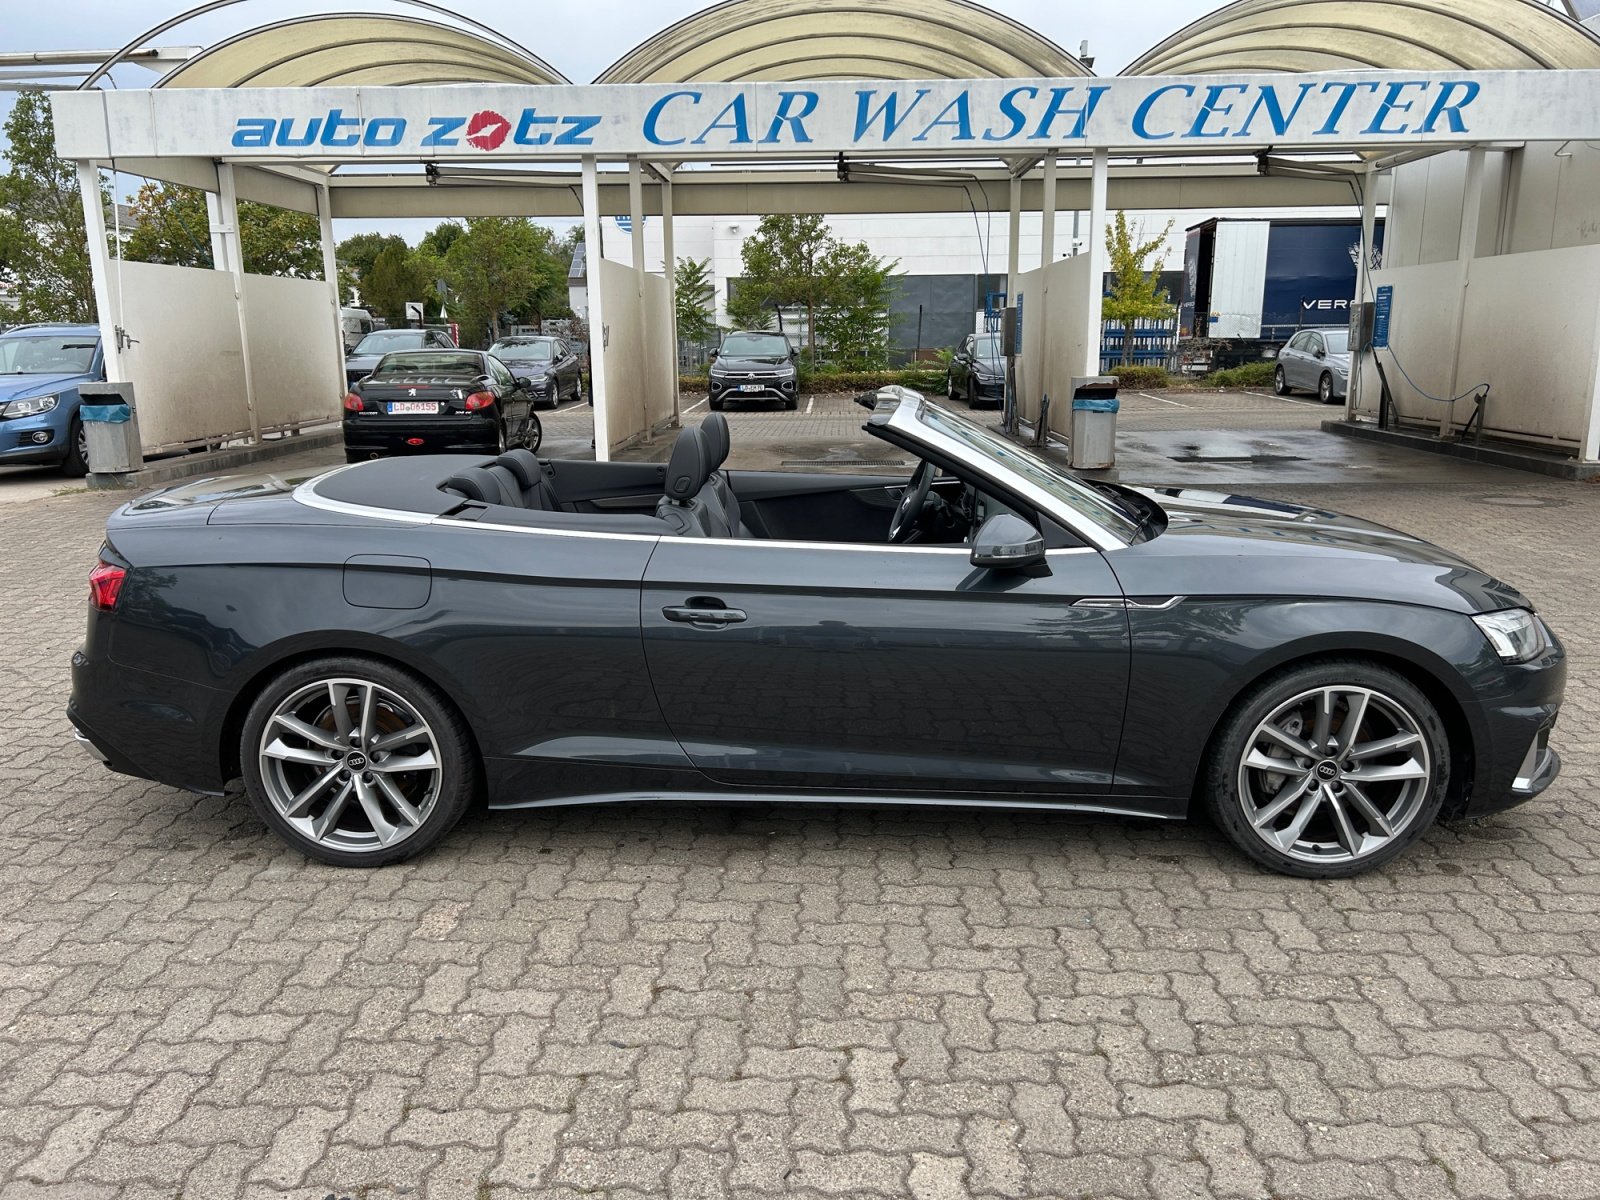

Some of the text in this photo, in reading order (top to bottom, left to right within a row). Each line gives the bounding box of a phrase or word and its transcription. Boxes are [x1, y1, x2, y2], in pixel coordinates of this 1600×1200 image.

[232, 109, 407, 148] auto
[643, 80, 1481, 146] CAR WASH CENTER
